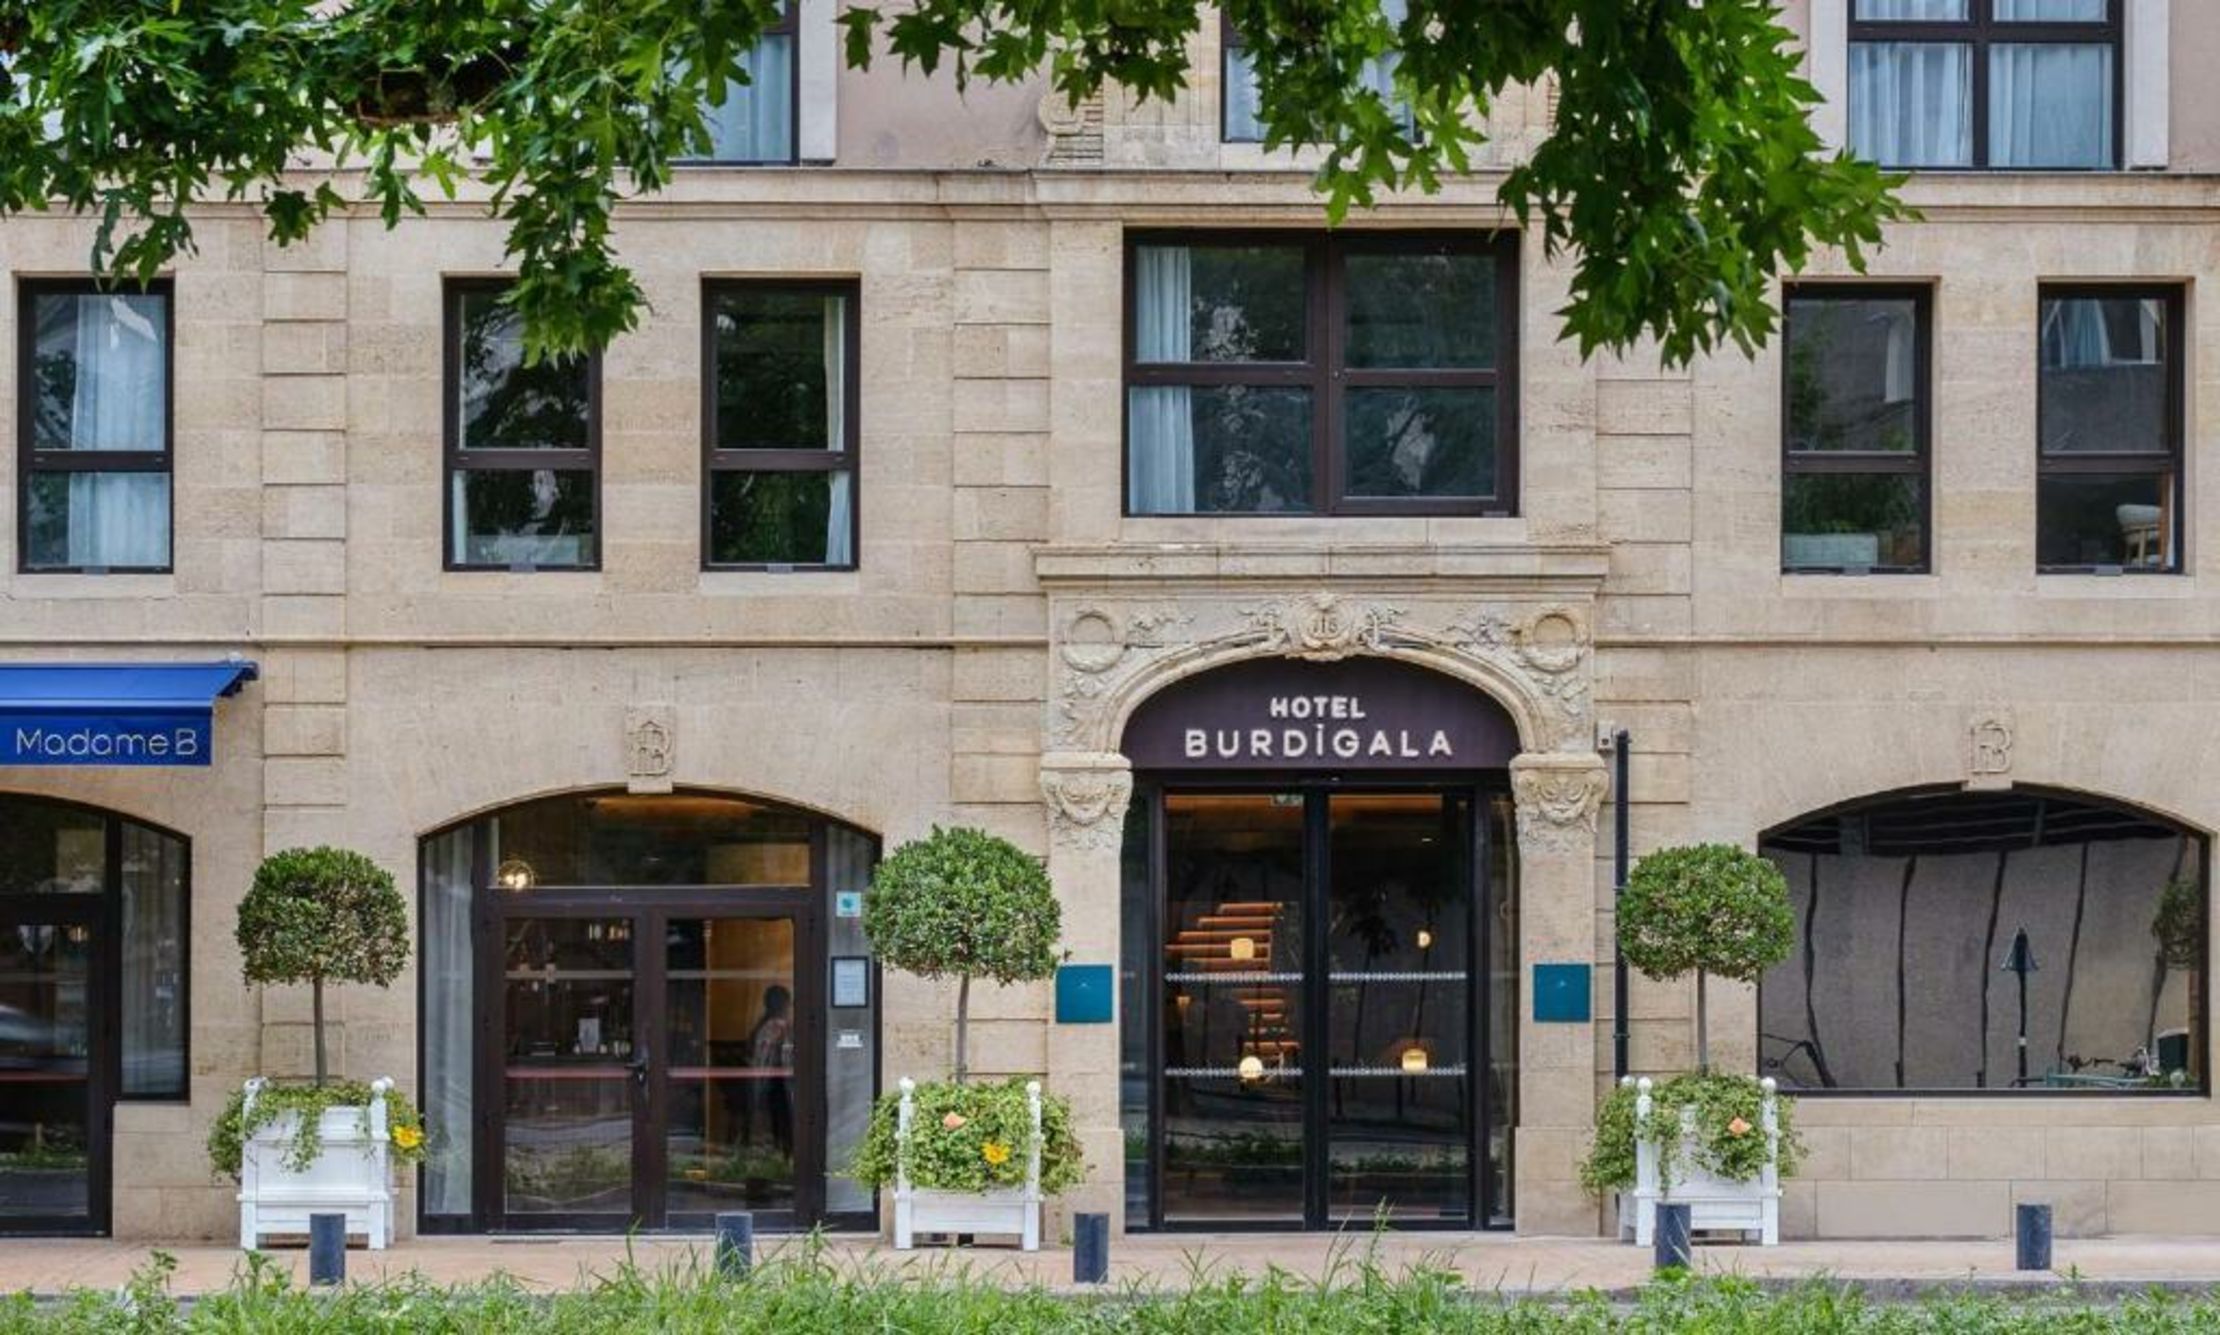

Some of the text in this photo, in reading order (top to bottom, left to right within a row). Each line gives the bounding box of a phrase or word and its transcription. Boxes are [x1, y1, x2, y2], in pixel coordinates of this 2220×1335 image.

[1270, 695, 1366, 719] HOTEL
[15, 727, 198, 756] Madame B
